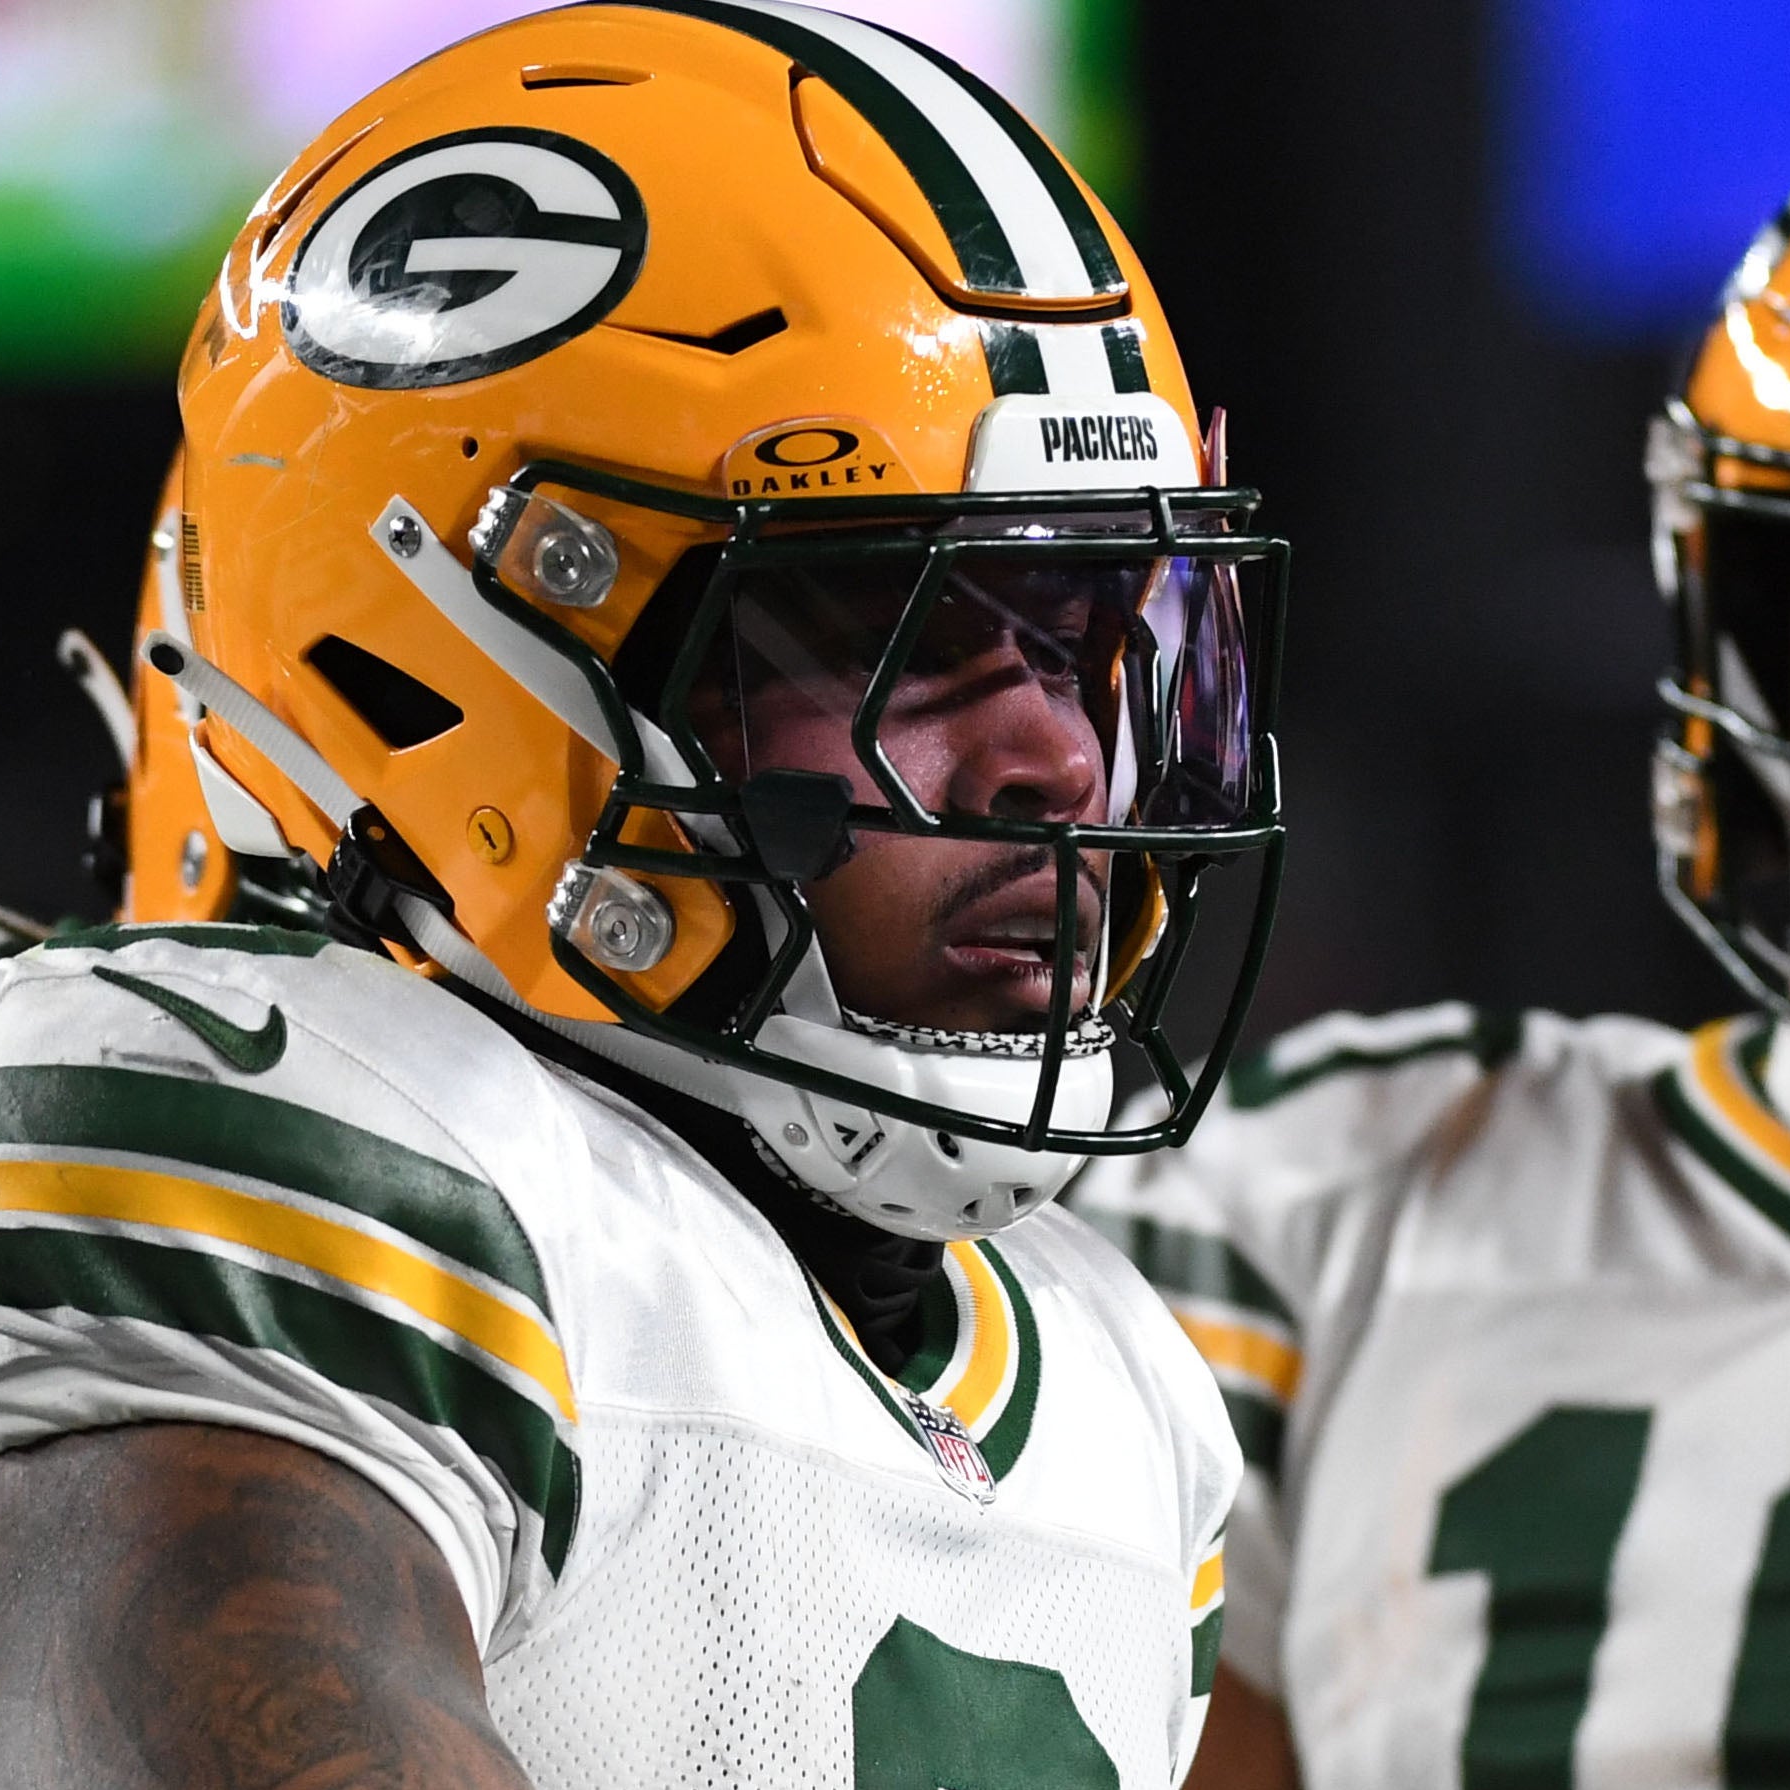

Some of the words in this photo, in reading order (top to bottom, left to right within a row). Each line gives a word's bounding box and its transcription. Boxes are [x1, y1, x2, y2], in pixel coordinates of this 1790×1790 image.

[293, 140, 624, 367] G
[1039, 416, 1158, 464] PACKERS
[732, 463, 888, 497] OAKLEY
[931, 1431, 987, 1485] NFL
